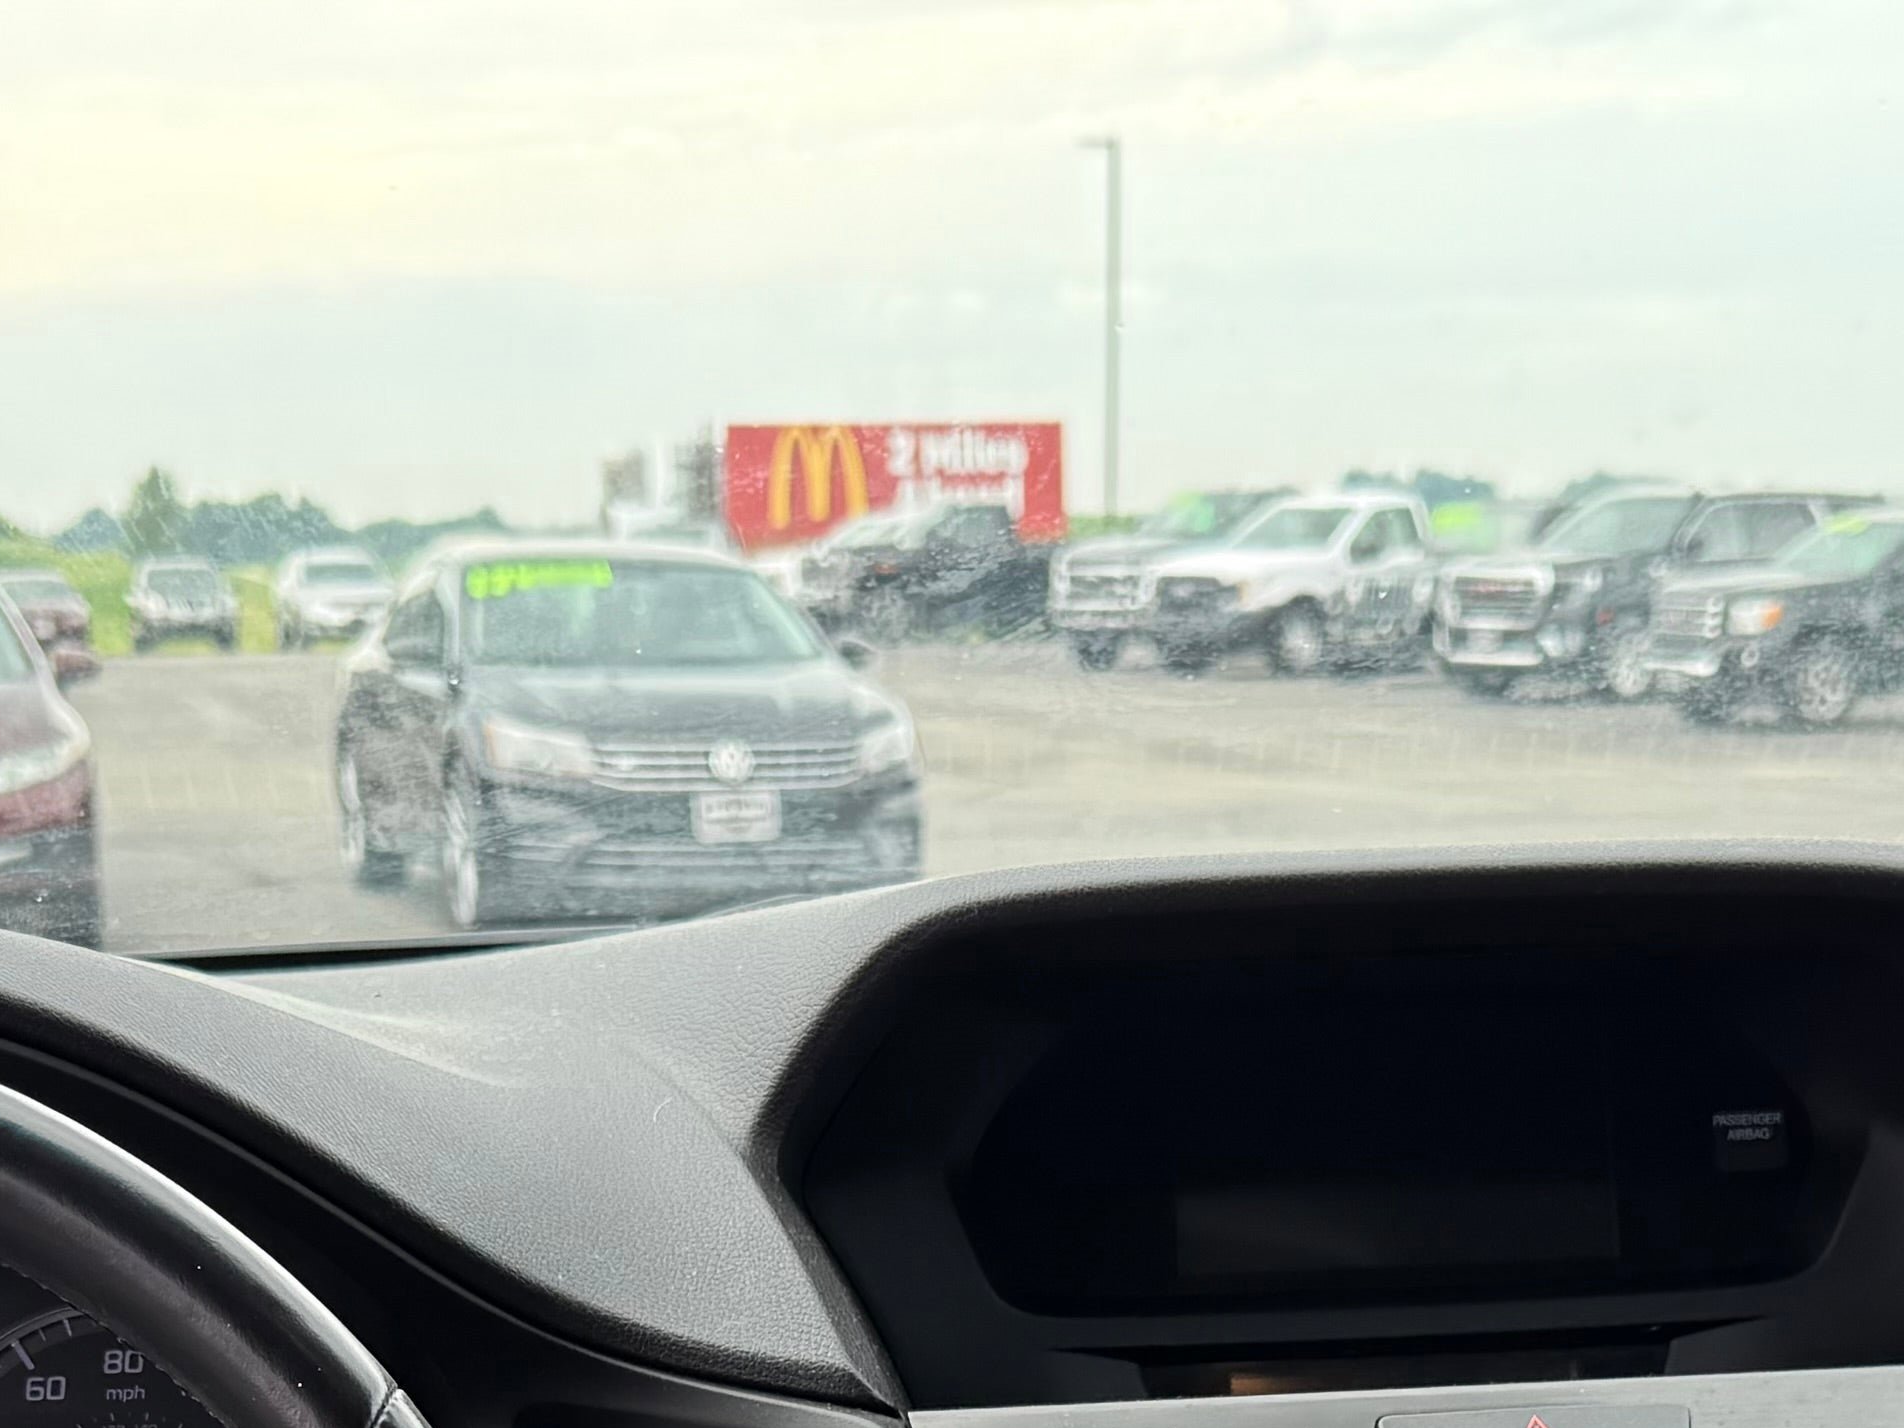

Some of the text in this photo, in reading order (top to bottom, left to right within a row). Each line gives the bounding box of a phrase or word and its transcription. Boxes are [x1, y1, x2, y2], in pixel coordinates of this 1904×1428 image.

[103, 1349, 145, 1375] 80
[25, 1376, 67, 1401] 60
[105, 1385, 146, 1403] mph
